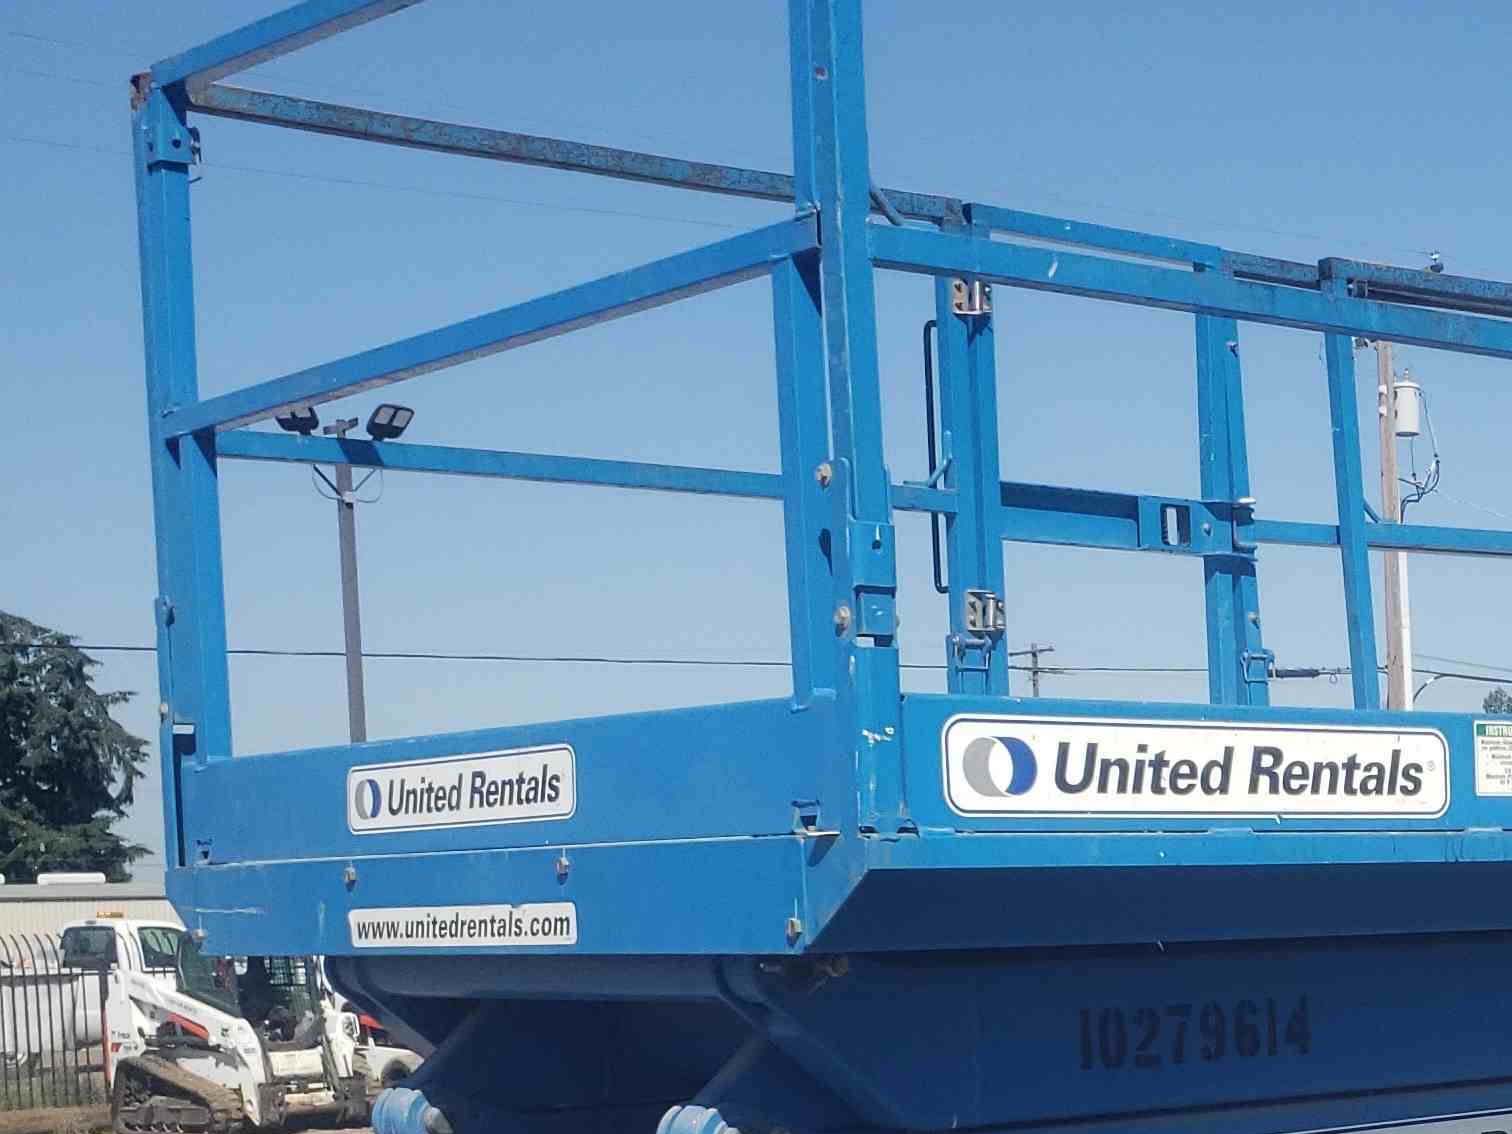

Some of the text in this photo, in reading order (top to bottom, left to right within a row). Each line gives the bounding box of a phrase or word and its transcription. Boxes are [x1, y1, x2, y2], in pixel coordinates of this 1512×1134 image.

[387, 764, 561, 816] United Rentals
[1054, 742, 1235, 796] United
[1248, 745, 1424, 797] Rentals
[357, 910, 571, 940] www.unitedrentals.com
[1079, 995, 1312, 1071] 10279614
